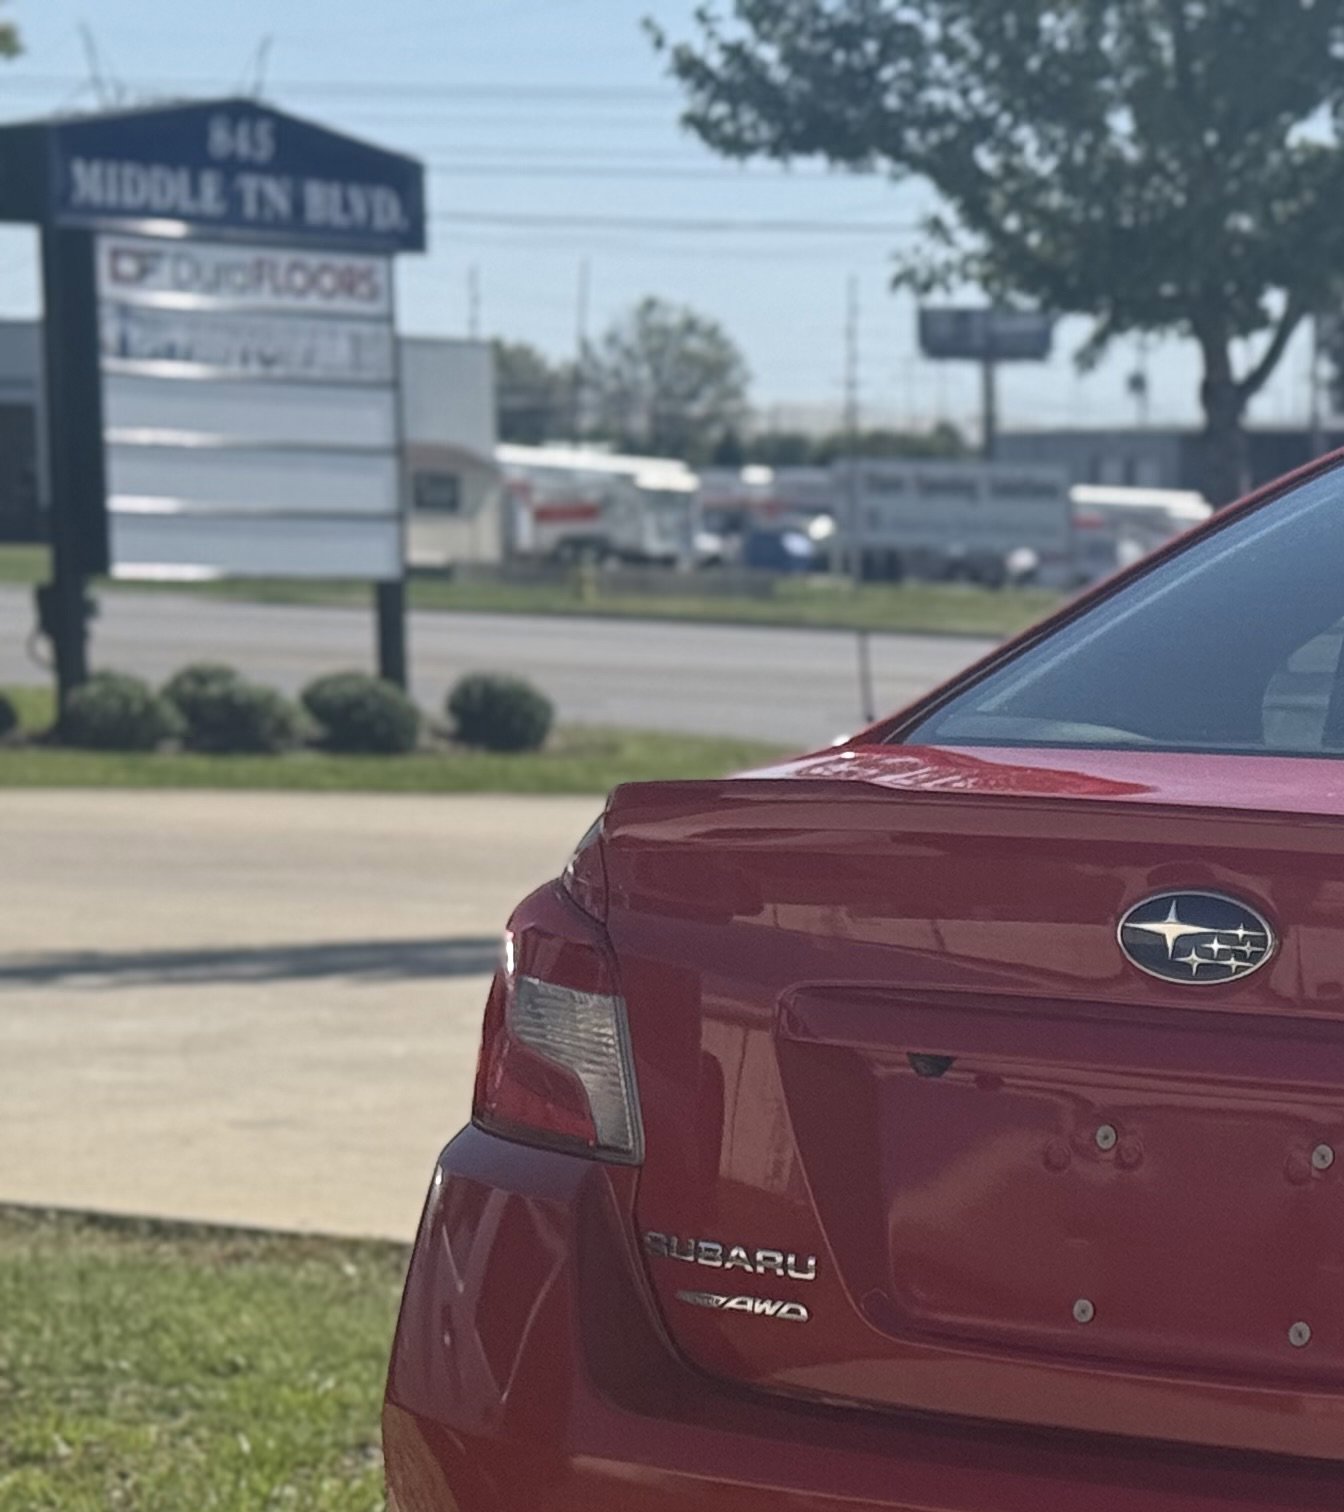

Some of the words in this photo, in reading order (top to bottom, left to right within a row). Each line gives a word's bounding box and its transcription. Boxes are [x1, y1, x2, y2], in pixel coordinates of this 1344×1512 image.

[72, 158, 226, 215] MIDDLE
[236, 173, 294, 223] TN
[643, 1231, 816, 1281] SUBARU
